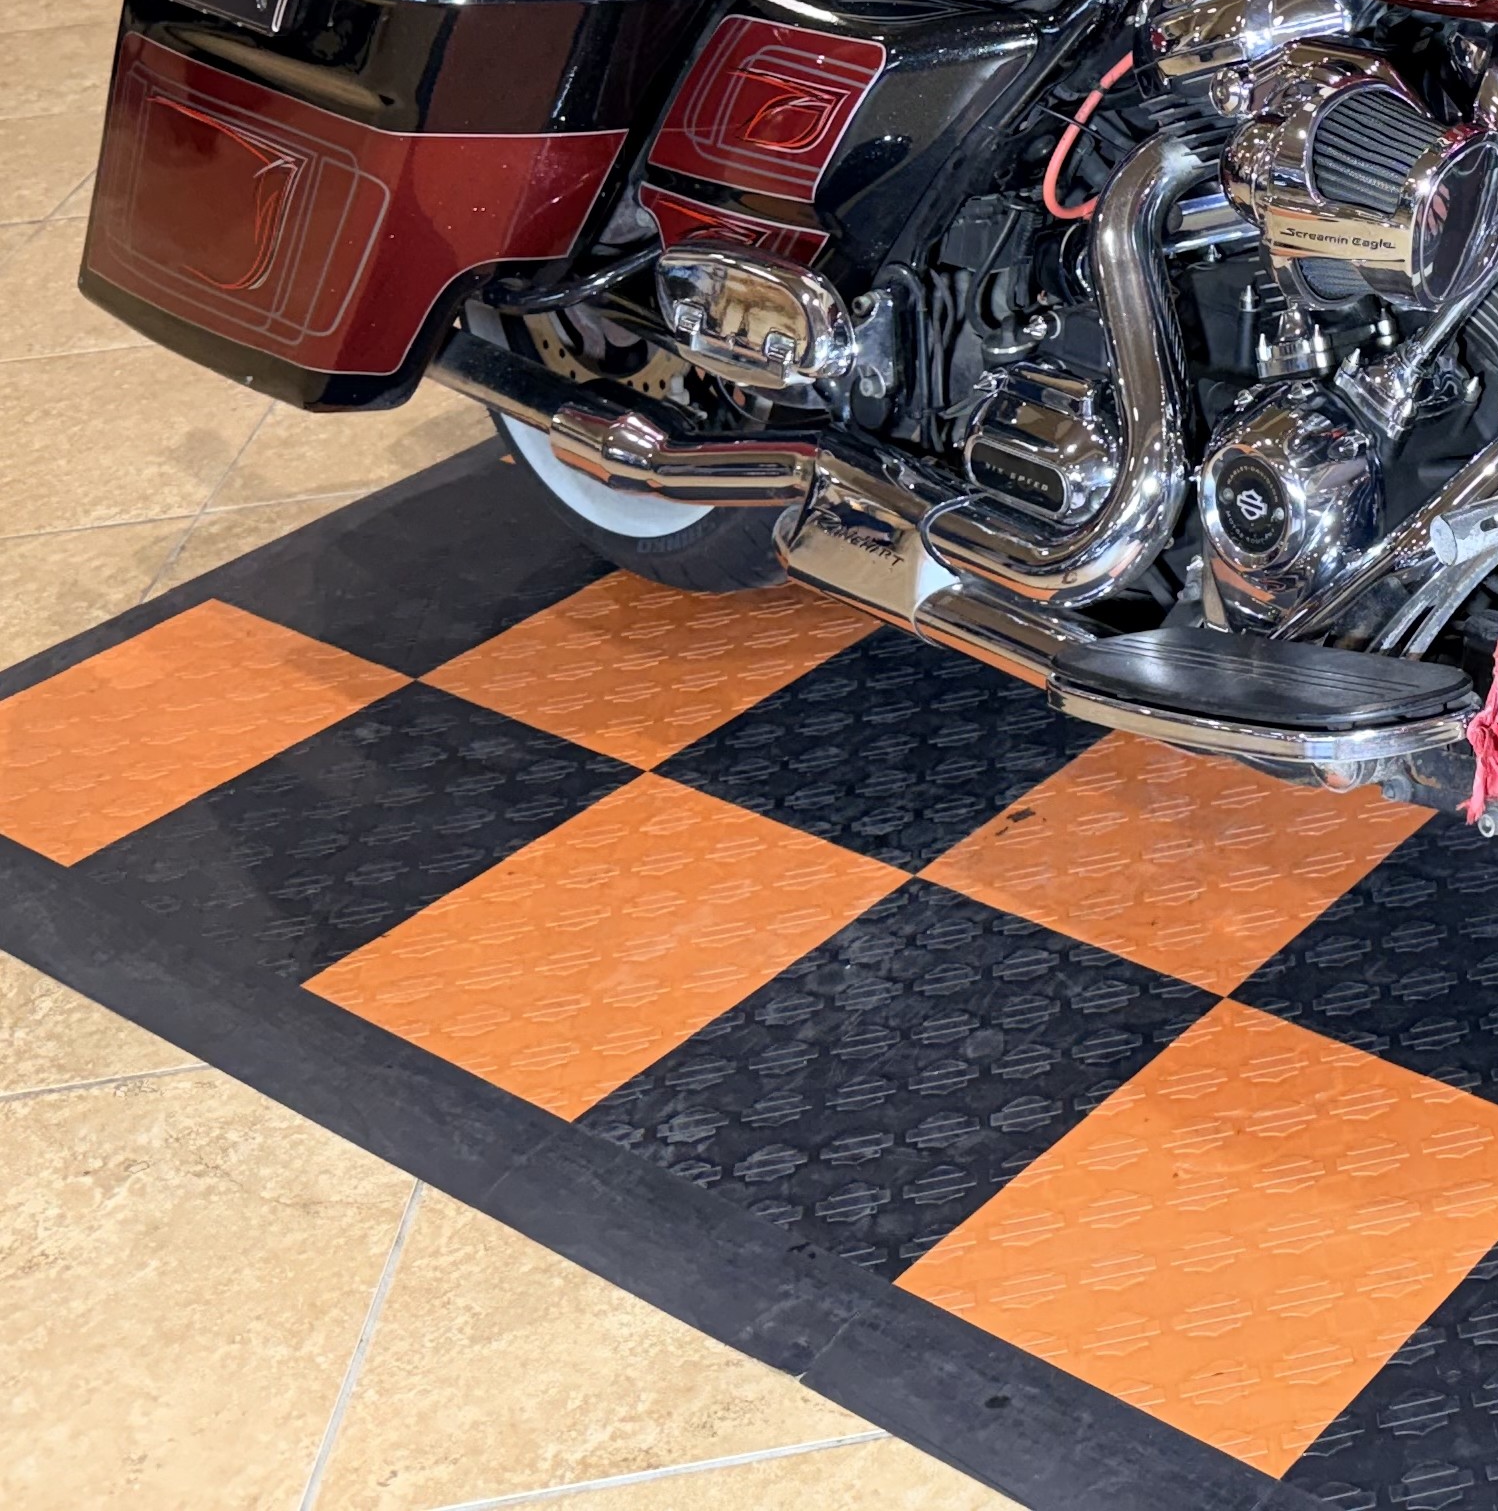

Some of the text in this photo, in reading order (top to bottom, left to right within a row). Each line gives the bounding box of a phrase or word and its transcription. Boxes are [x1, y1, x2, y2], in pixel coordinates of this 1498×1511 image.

[1279, 227, 1397, 250] Screamin Eagle
[1009, 472, 1049, 492] SPEED
